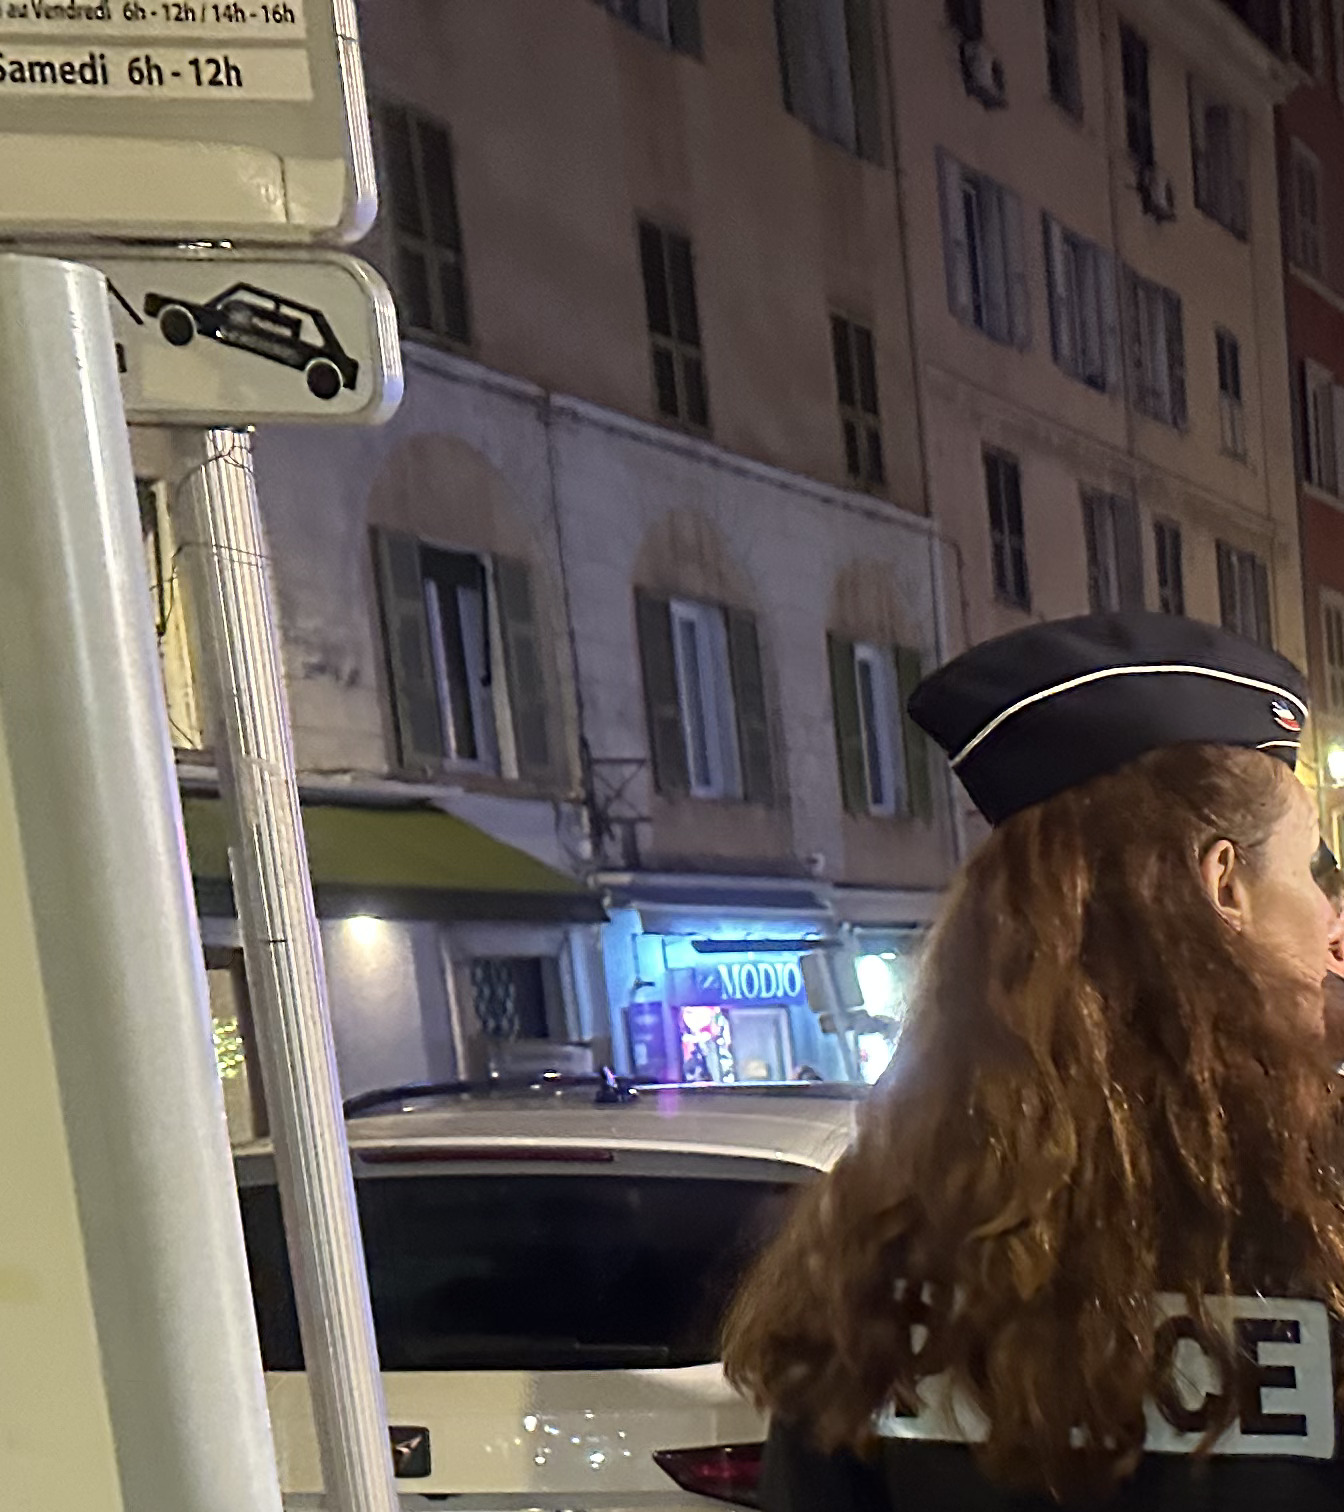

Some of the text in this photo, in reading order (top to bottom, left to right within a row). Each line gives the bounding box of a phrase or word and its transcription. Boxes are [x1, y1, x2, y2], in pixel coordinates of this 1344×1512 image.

[123, 2, 146, 20] 6h
[164, 3, 196, 22] 12h
[214, 2, 246, 23] 14h
[263, 4, 295, 24] 16h
[128, 55, 163, 85] 6h
[188, 55, 243, 87] 12h
